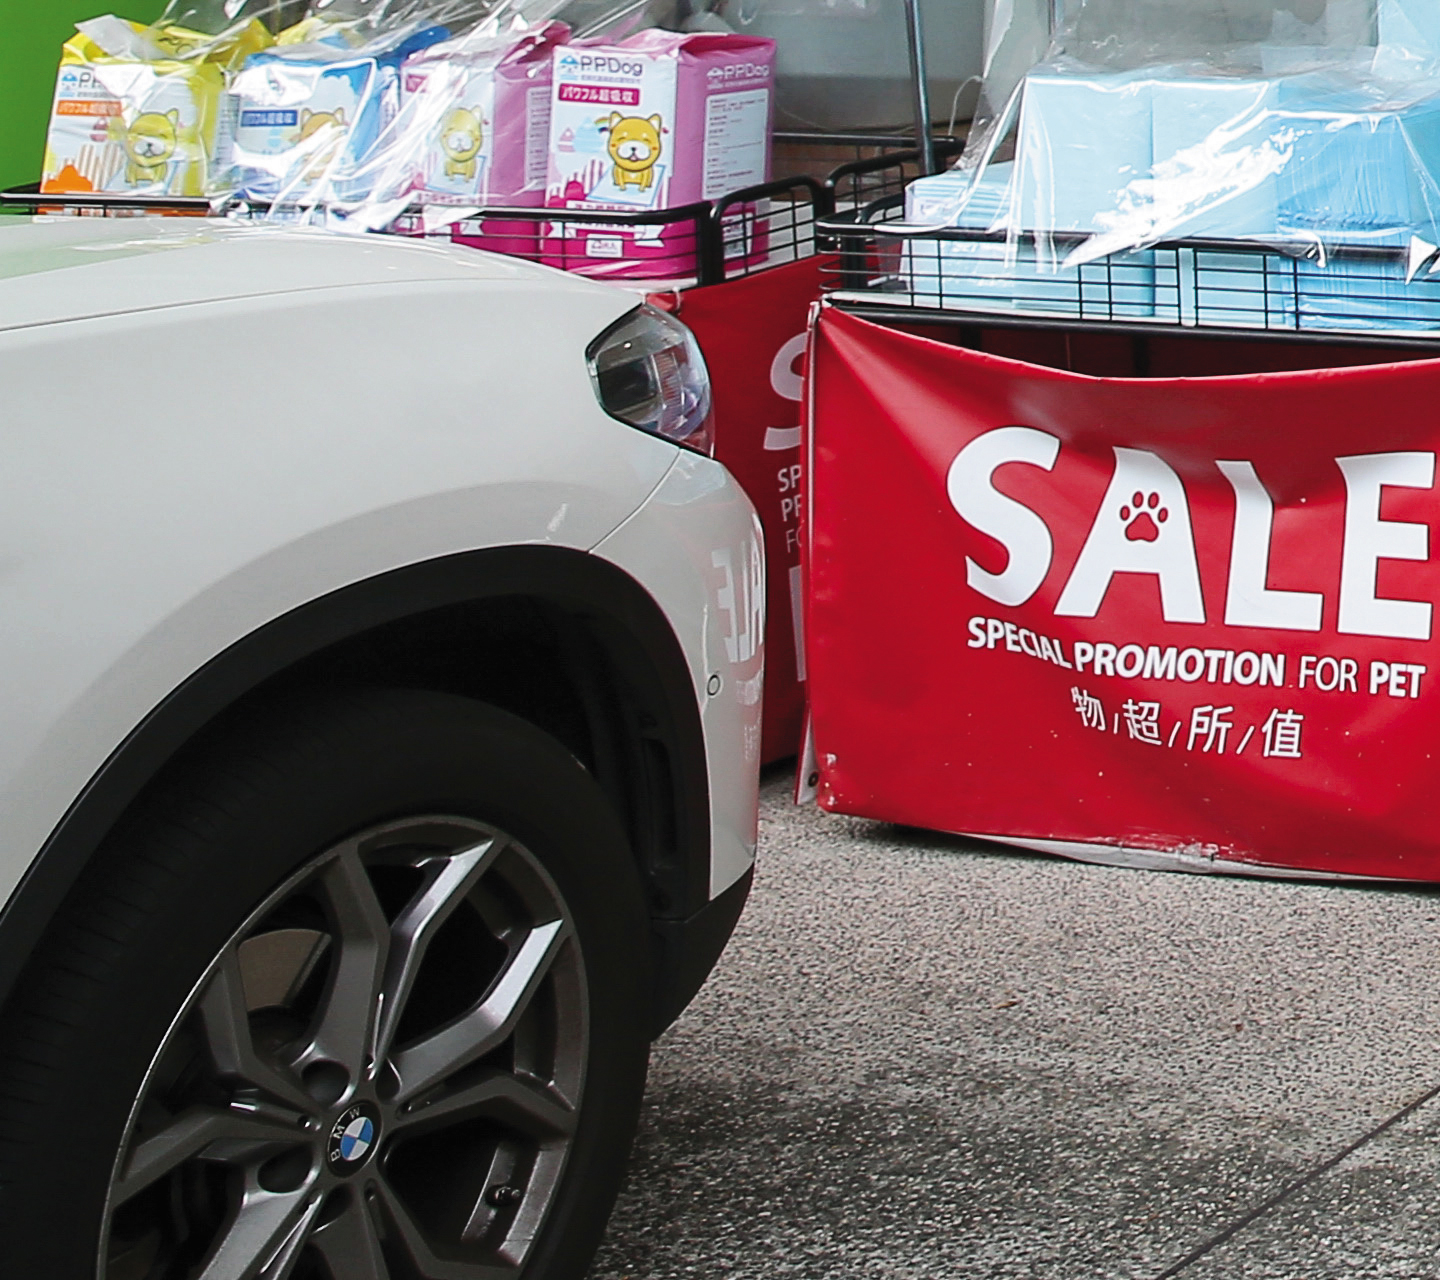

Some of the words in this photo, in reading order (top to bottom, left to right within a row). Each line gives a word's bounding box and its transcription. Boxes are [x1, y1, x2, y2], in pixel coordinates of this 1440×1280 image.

[945, 425, 1437, 641] SALE
[966, 615, 1071, 671] SPECIAL
[1075, 640, 1285, 688] PROMOTION
[1297, 655, 1358, 695] FOR
[1367, 658, 1428, 700] PET
